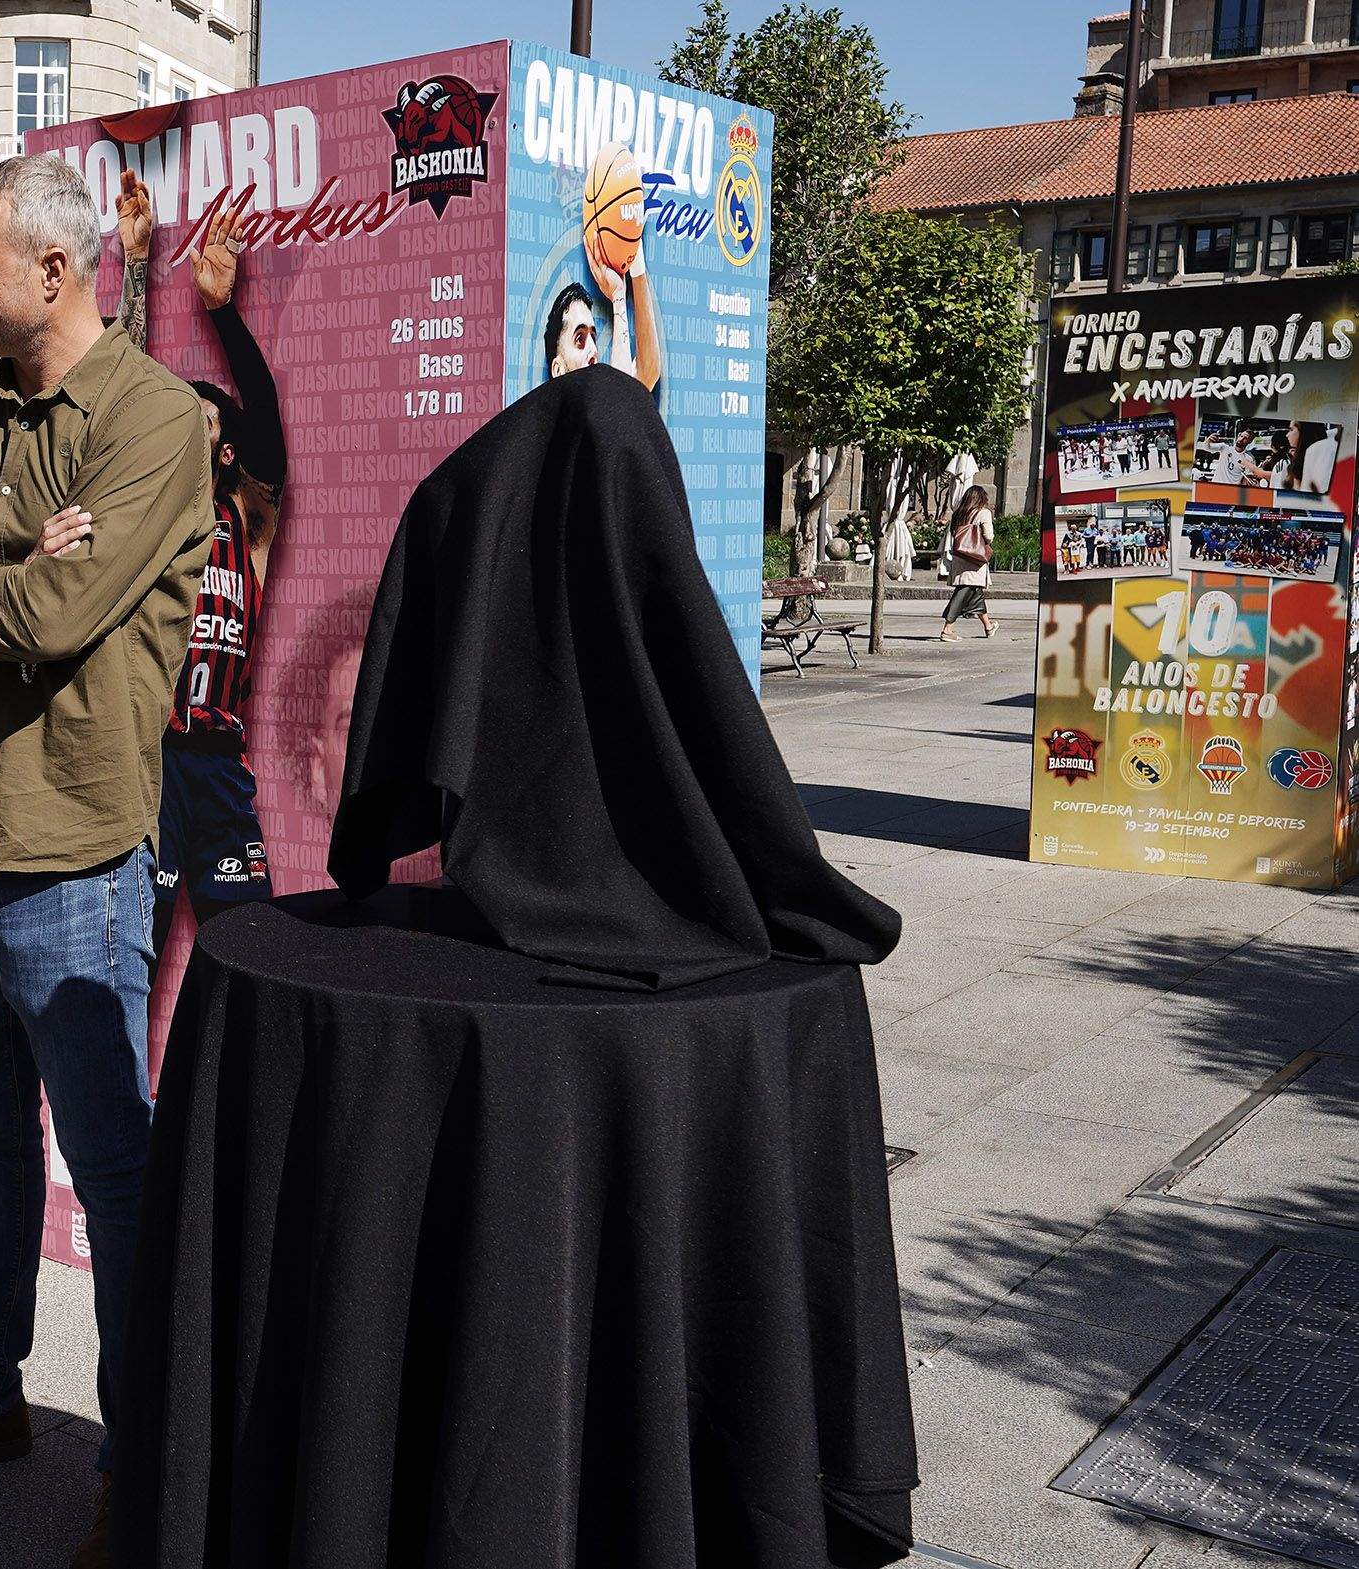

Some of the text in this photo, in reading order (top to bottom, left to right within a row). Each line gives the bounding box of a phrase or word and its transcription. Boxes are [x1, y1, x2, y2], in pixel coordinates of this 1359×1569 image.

[524, 60, 715, 200] CAMPAZZO
[395, 146, 485, 188] BASKONIA
[168, 176, 409, 267] Markus
[642, 172, 715, 245] Facu
[398, 218, 492, 258] BASKONIA
[341, 259, 432, 296] BASKONIA
[430, 274, 464, 302] USA
[293, 298, 381, 332] BASKONIA
[709, 289, 751, 316] Argentina
[392, 316, 464, 344] 26 anos
[715, 324, 750, 349] 34 anos
[1062, 310, 1141, 335] TORNEO
[1063, 313, 1355, 373] ENCESTARÍAS
[293, 361, 381, 394] BASKONIA
[419, 353, 463, 379] Base
[728, 358, 750, 381] Base
[1110, 373, 1296, 403] X ANIVERSARIO
[404, 390, 463, 419] 1,78 m
[721, 391, 749, 416] 1,78 m
[293, 424, 381, 454] BASKONIA
[702, 428, 724, 453] REAL
[727, 429, 762, 453] MADRID
[726, 464, 749, 488] REAL
[294, 486, 381, 514] BASKONIA
[701, 500, 761, 524] REAL MADRID
[295, 549, 381, 575] BASKONIA
[1156, 590, 1238, 657] 10
[1121, 660, 1251, 690] ANOS DE
[1092, 687, 1279, 720] BALONCESTO
[1048, 757, 1095, 773] BASKONIA
[1053, 800, 1133, 817] PONTEVEDRA
[1148, 806, 1213, 823] PAVILLÓN
[1217, 812, 1234, 824] DE
[1239, 814, 1306, 830] DEPORTES
[1124, 820, 1231, 839] 19-20 SETEMBRO
[1272, 858, 1303, 868] XUNTA
[1272, 866, 1322, 878] DE GALICIA
[214, 874, 249, 882] HYUNDAI
